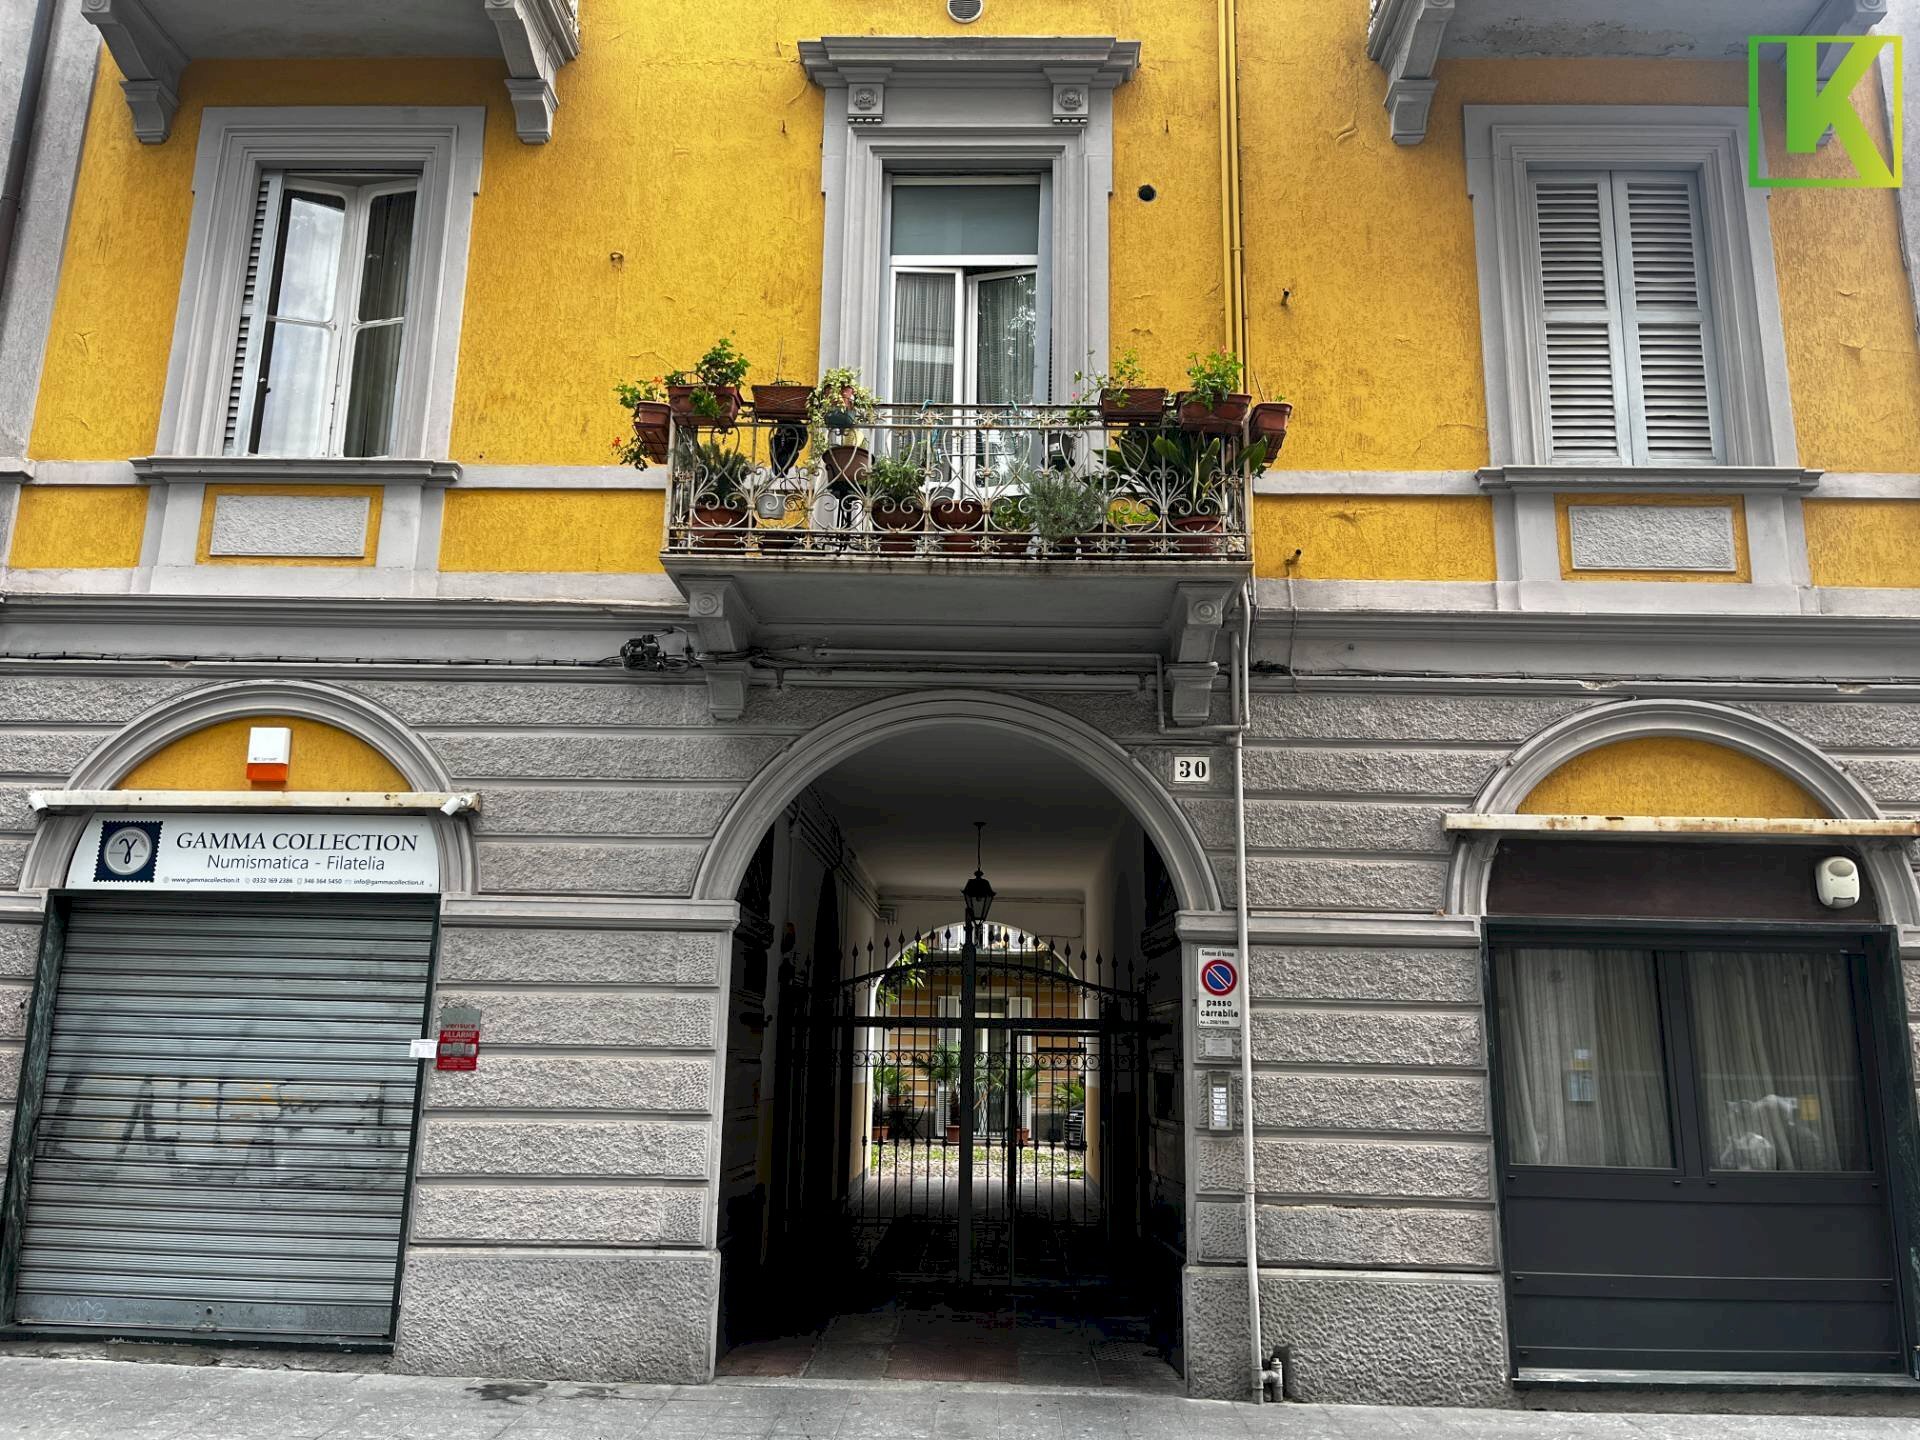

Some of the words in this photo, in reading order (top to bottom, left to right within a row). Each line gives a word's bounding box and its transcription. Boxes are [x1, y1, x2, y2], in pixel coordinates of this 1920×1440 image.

[1179, 760, 1207, 778] 30
[176, 832, 266, 850] GAMMA
[272, 833, 418, 851] COLLECTION
[207, 854, 309, 870] Numismatica
[327, 855, 385, 871] Filatelia
[353, 878, 425, 886] info@gammacollection.it
[1200, 1009, 1239, 1018] carrabile
